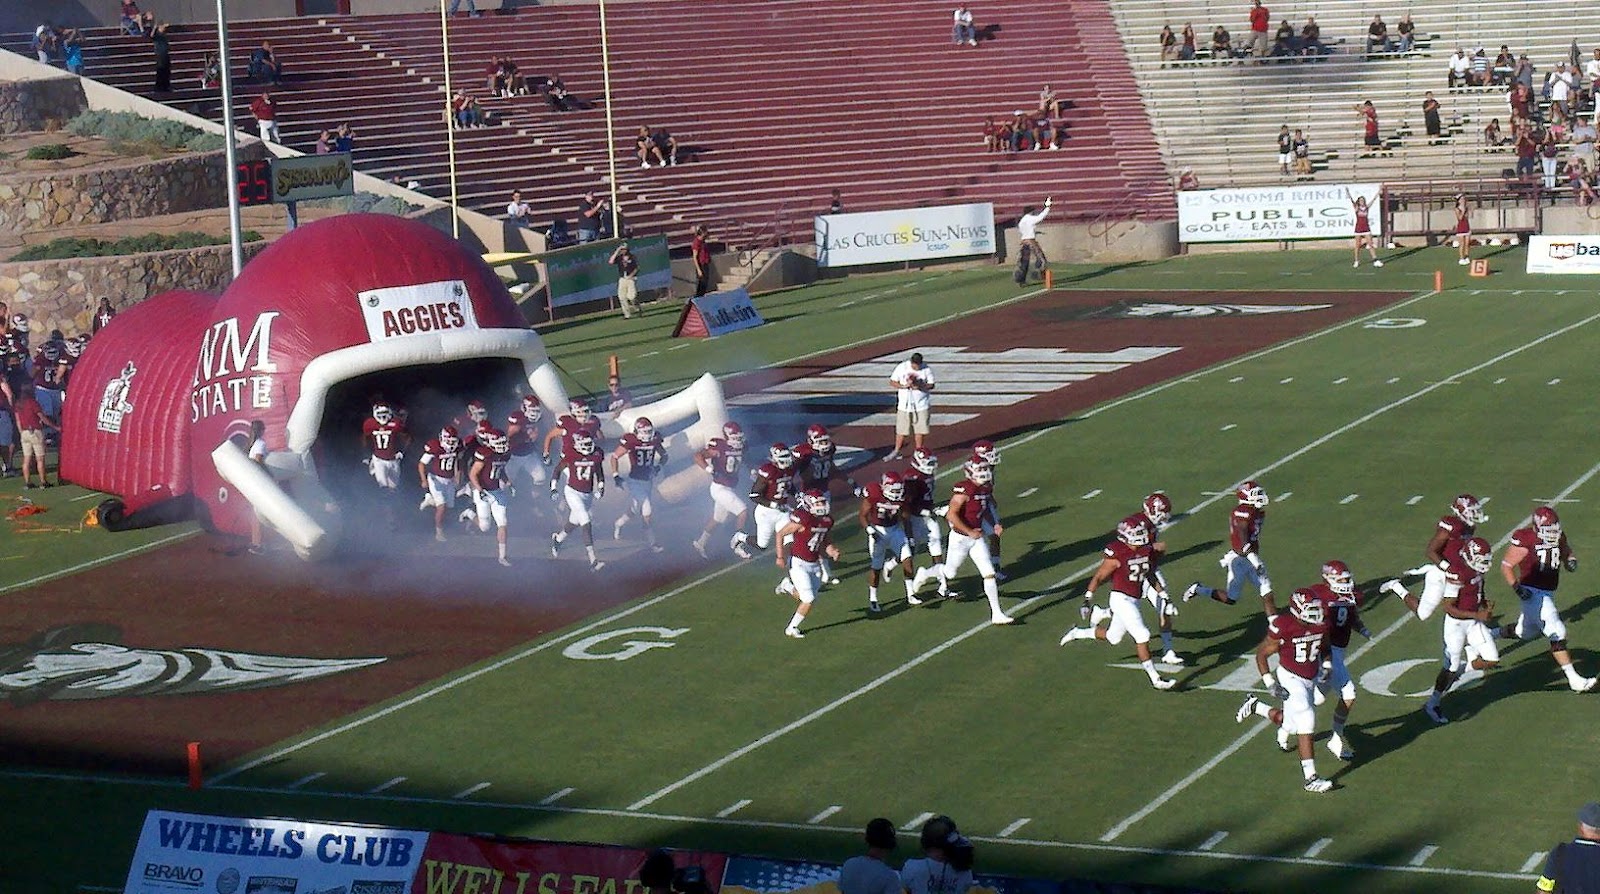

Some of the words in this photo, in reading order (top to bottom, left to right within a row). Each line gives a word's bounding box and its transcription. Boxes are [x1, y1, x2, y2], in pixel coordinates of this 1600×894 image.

[237, 163, 267, 203] 25
[1210, 192, 1284, 206] SONOMA
[1186, 223, 1231, 234] GOLF
[1252, 221, 1288, 231] EATS
[1314, 218, 1375, 229] DRINS
[1212, 207, 1348, 222] PUBLIC
[853, 231, 909, 248] CRUCES
[912, 223, 988, 243] SUN-NEWS
[382, 302, 466, 338] AGGIES
[193, 311, 280, 387] NM
[191, 374, 273, 423] STATE
[1337, 606, 1349, 627] 9
[562, 627, 691, 661] G
[158, 818, 305, 860] WHEELS
[316, 832, 414, 868] CLUB
[144, 863, 203, 882] BRAVO
